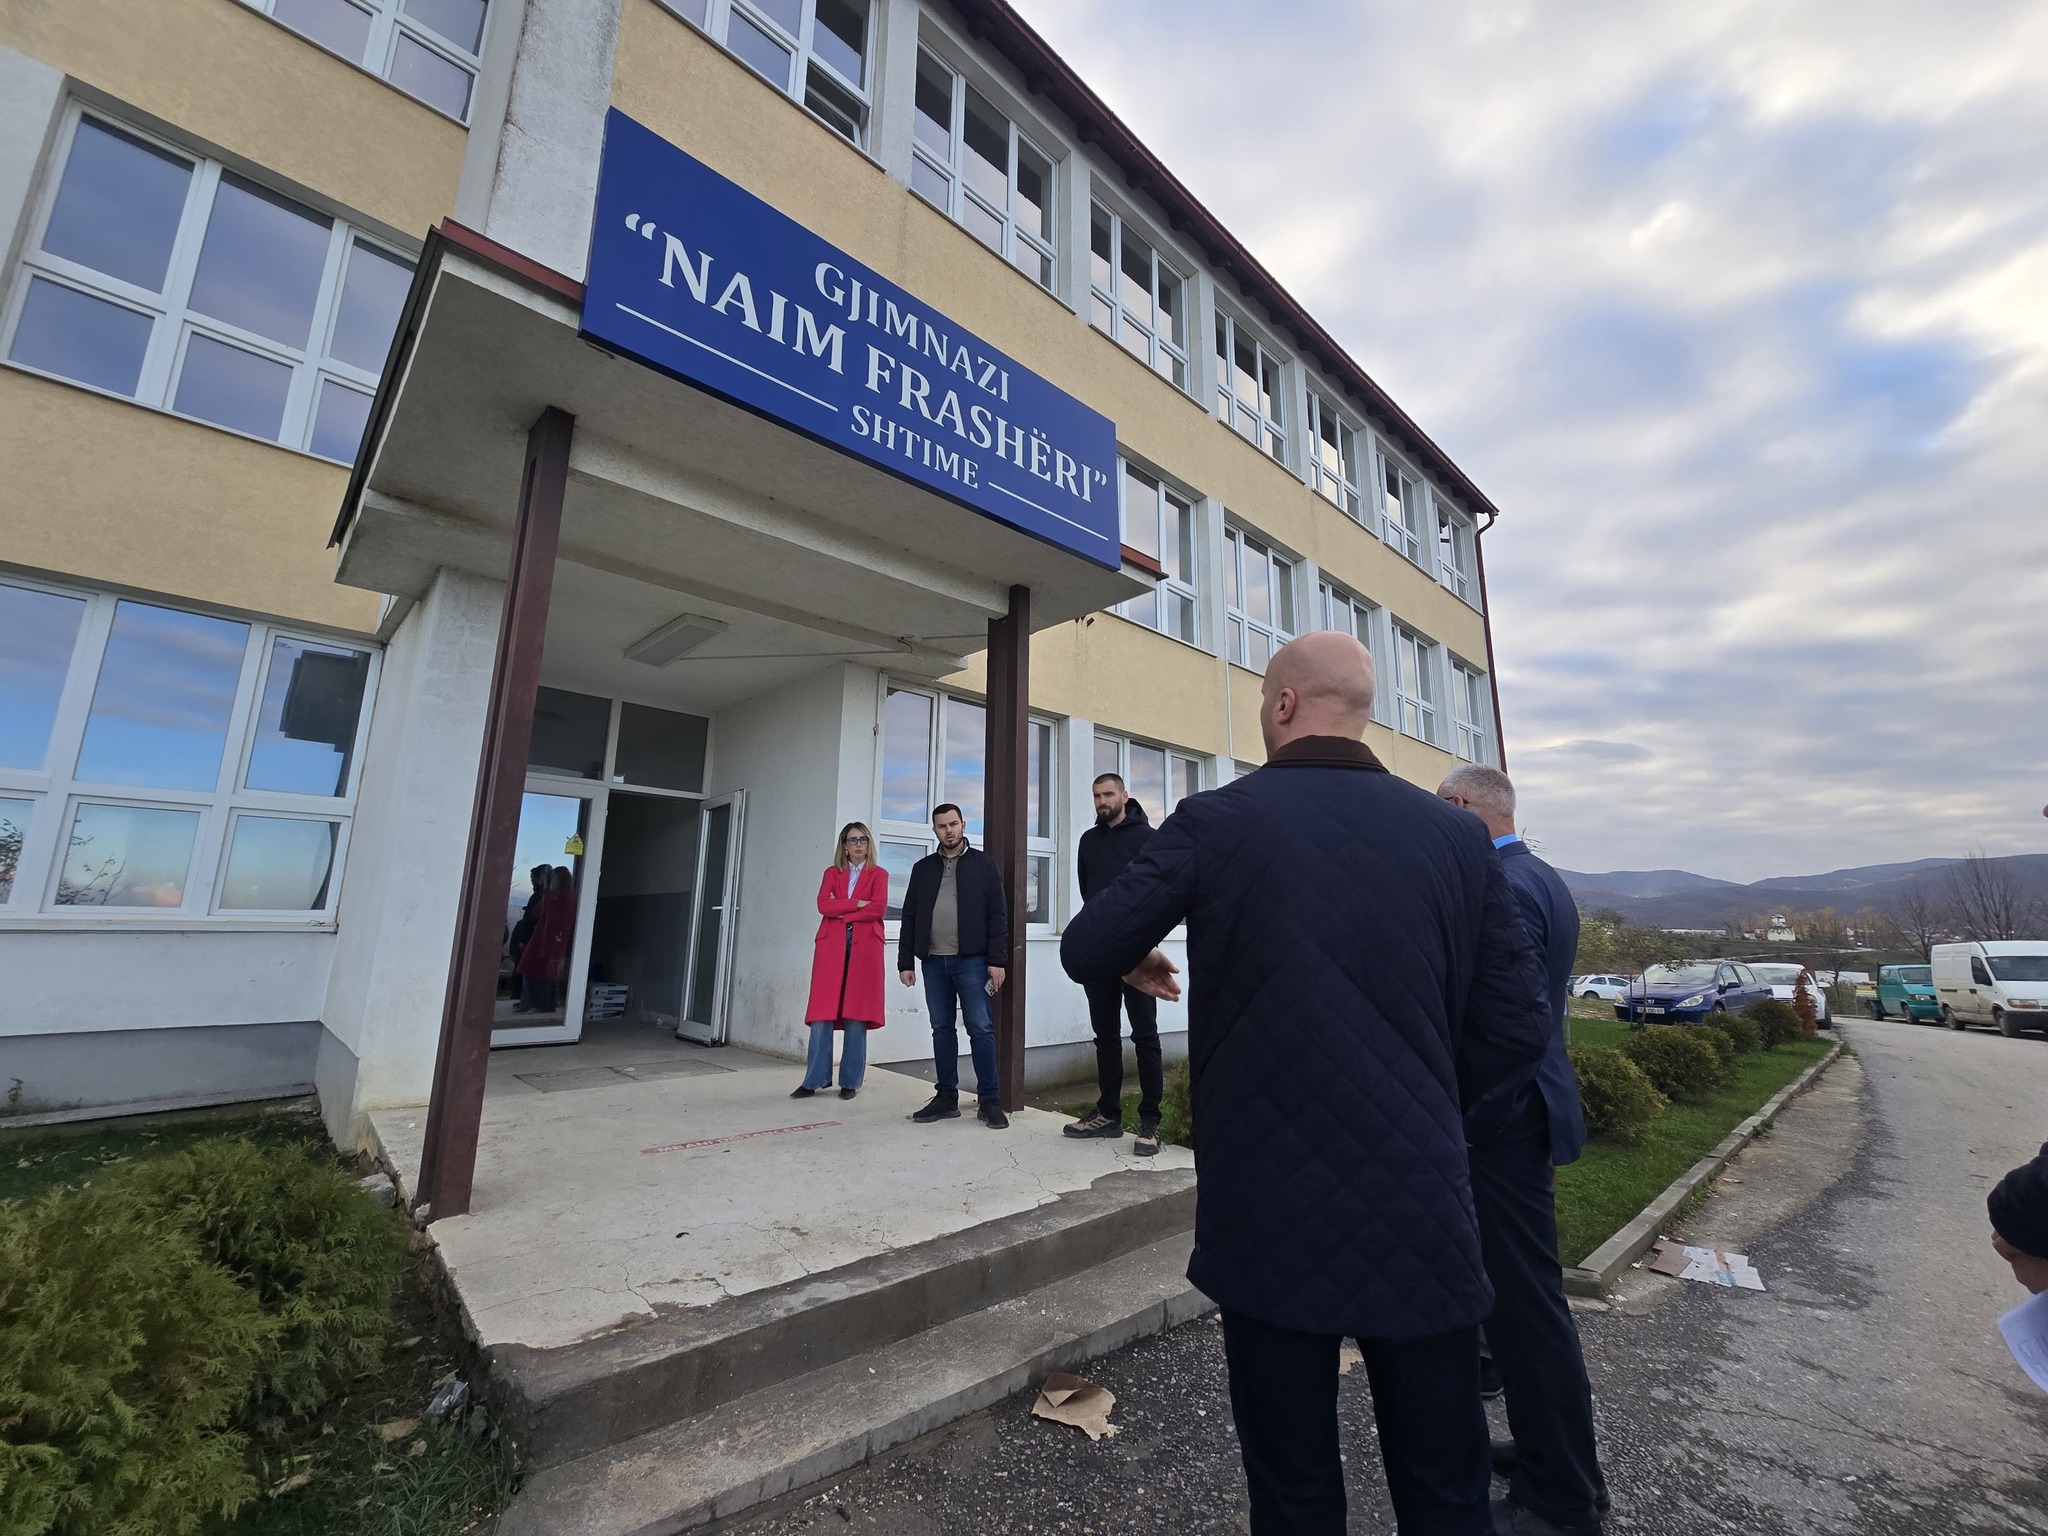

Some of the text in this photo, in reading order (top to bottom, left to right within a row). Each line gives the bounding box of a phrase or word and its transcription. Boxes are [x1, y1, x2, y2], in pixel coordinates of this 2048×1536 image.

[624, 213, 1108, 504] “NAIM FRASHËRI”
[815, 262, 1010, 403] GJIMNAZI
[850, 405, 979, 490] SHTIME
